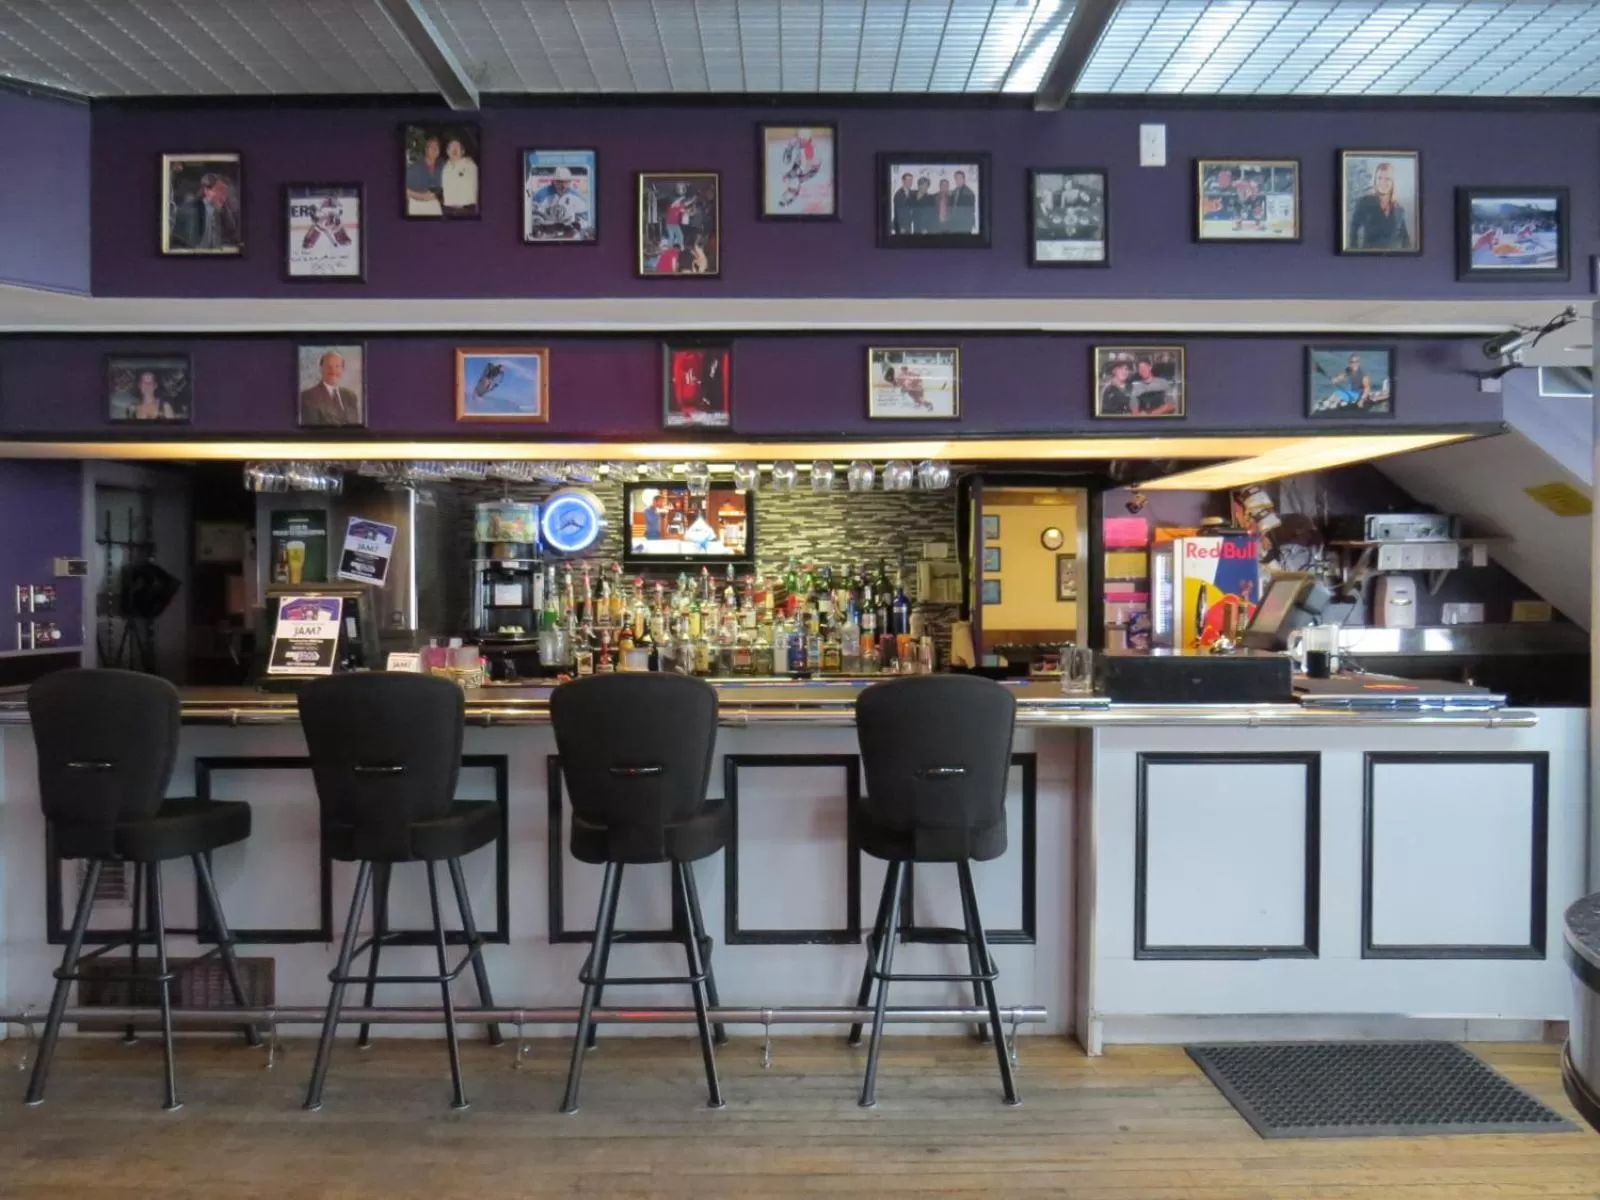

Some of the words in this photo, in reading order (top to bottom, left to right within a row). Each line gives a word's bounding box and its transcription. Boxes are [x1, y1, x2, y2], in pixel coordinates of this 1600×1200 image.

[1186, 542, 1220, 559] Red
[1223, 542, 1257, 560] Bull
[293, 626, 322, 637] JAM?
